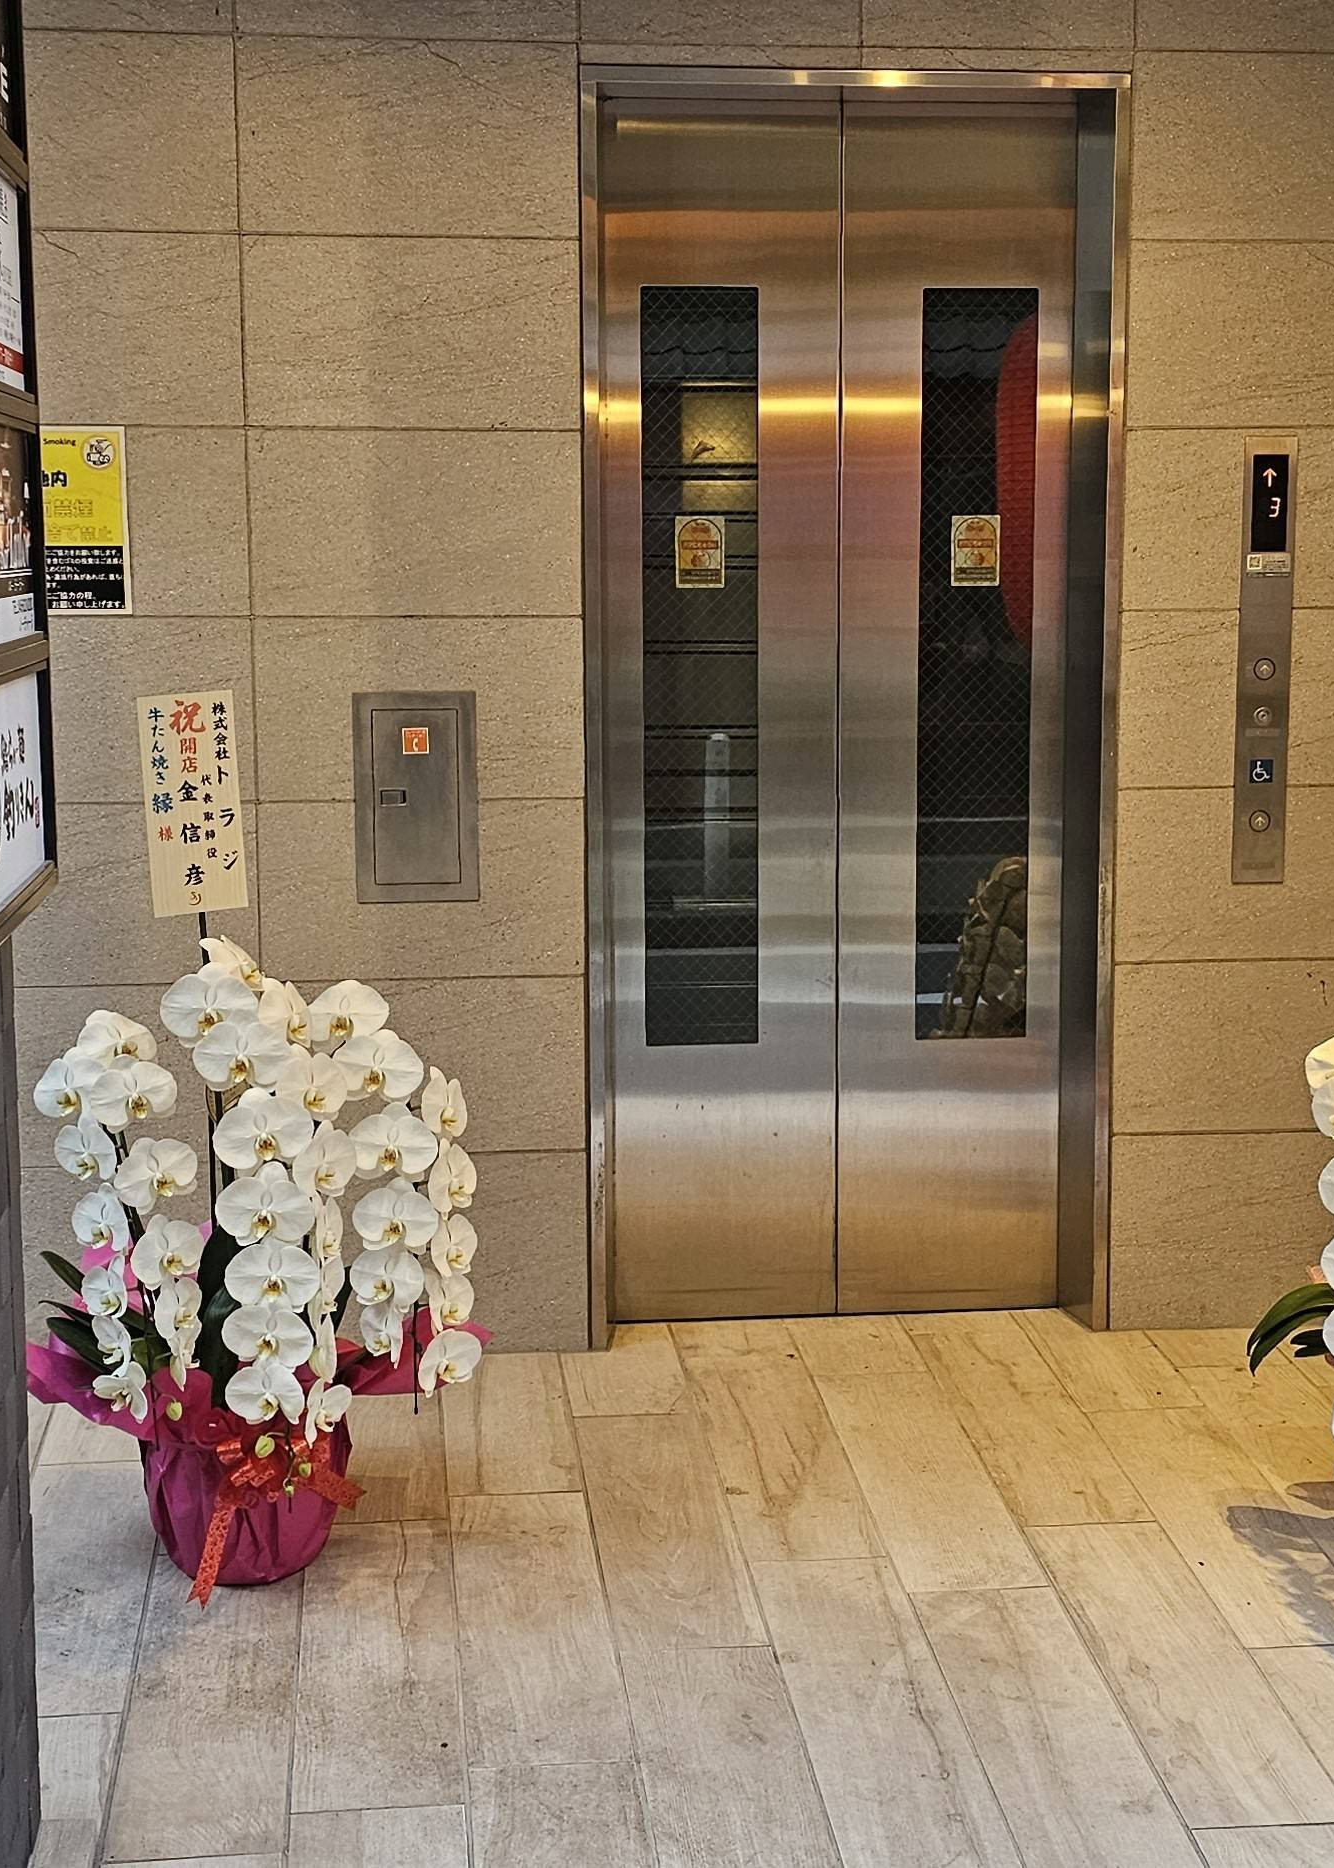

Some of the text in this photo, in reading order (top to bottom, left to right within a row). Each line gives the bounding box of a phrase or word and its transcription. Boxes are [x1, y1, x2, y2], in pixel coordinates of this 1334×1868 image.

[1269, 497, 1280, 518] 3
[147, 707, 169, 785] 牛たん焼き
[157, 826, 174, 842] 様
